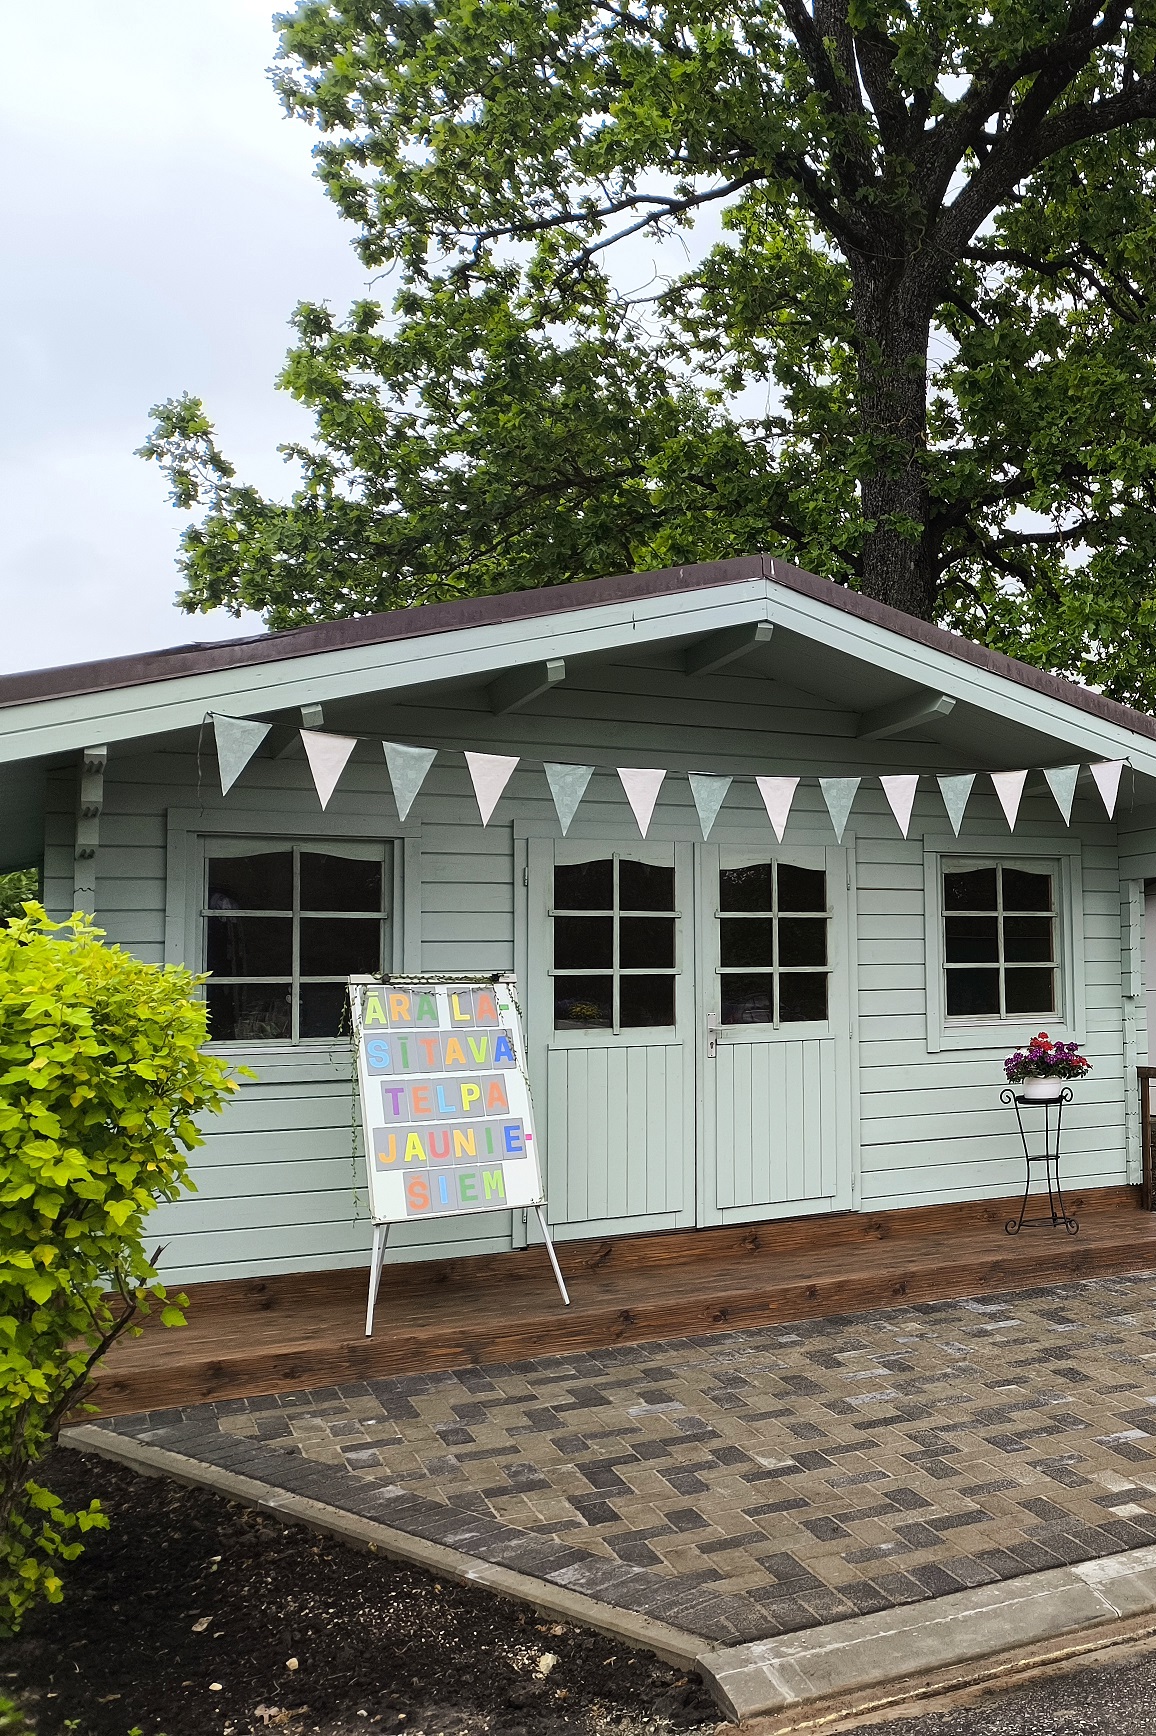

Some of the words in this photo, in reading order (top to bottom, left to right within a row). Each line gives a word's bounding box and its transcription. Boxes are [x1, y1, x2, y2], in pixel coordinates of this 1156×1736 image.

[364, 991, 437, 1025] ĀRA
[367, 1035, 515, 1069] SĪTAVA
[384, 1080, 508, 1116] TELPA
[407, 1169, 505, 1211] ŠIEM
